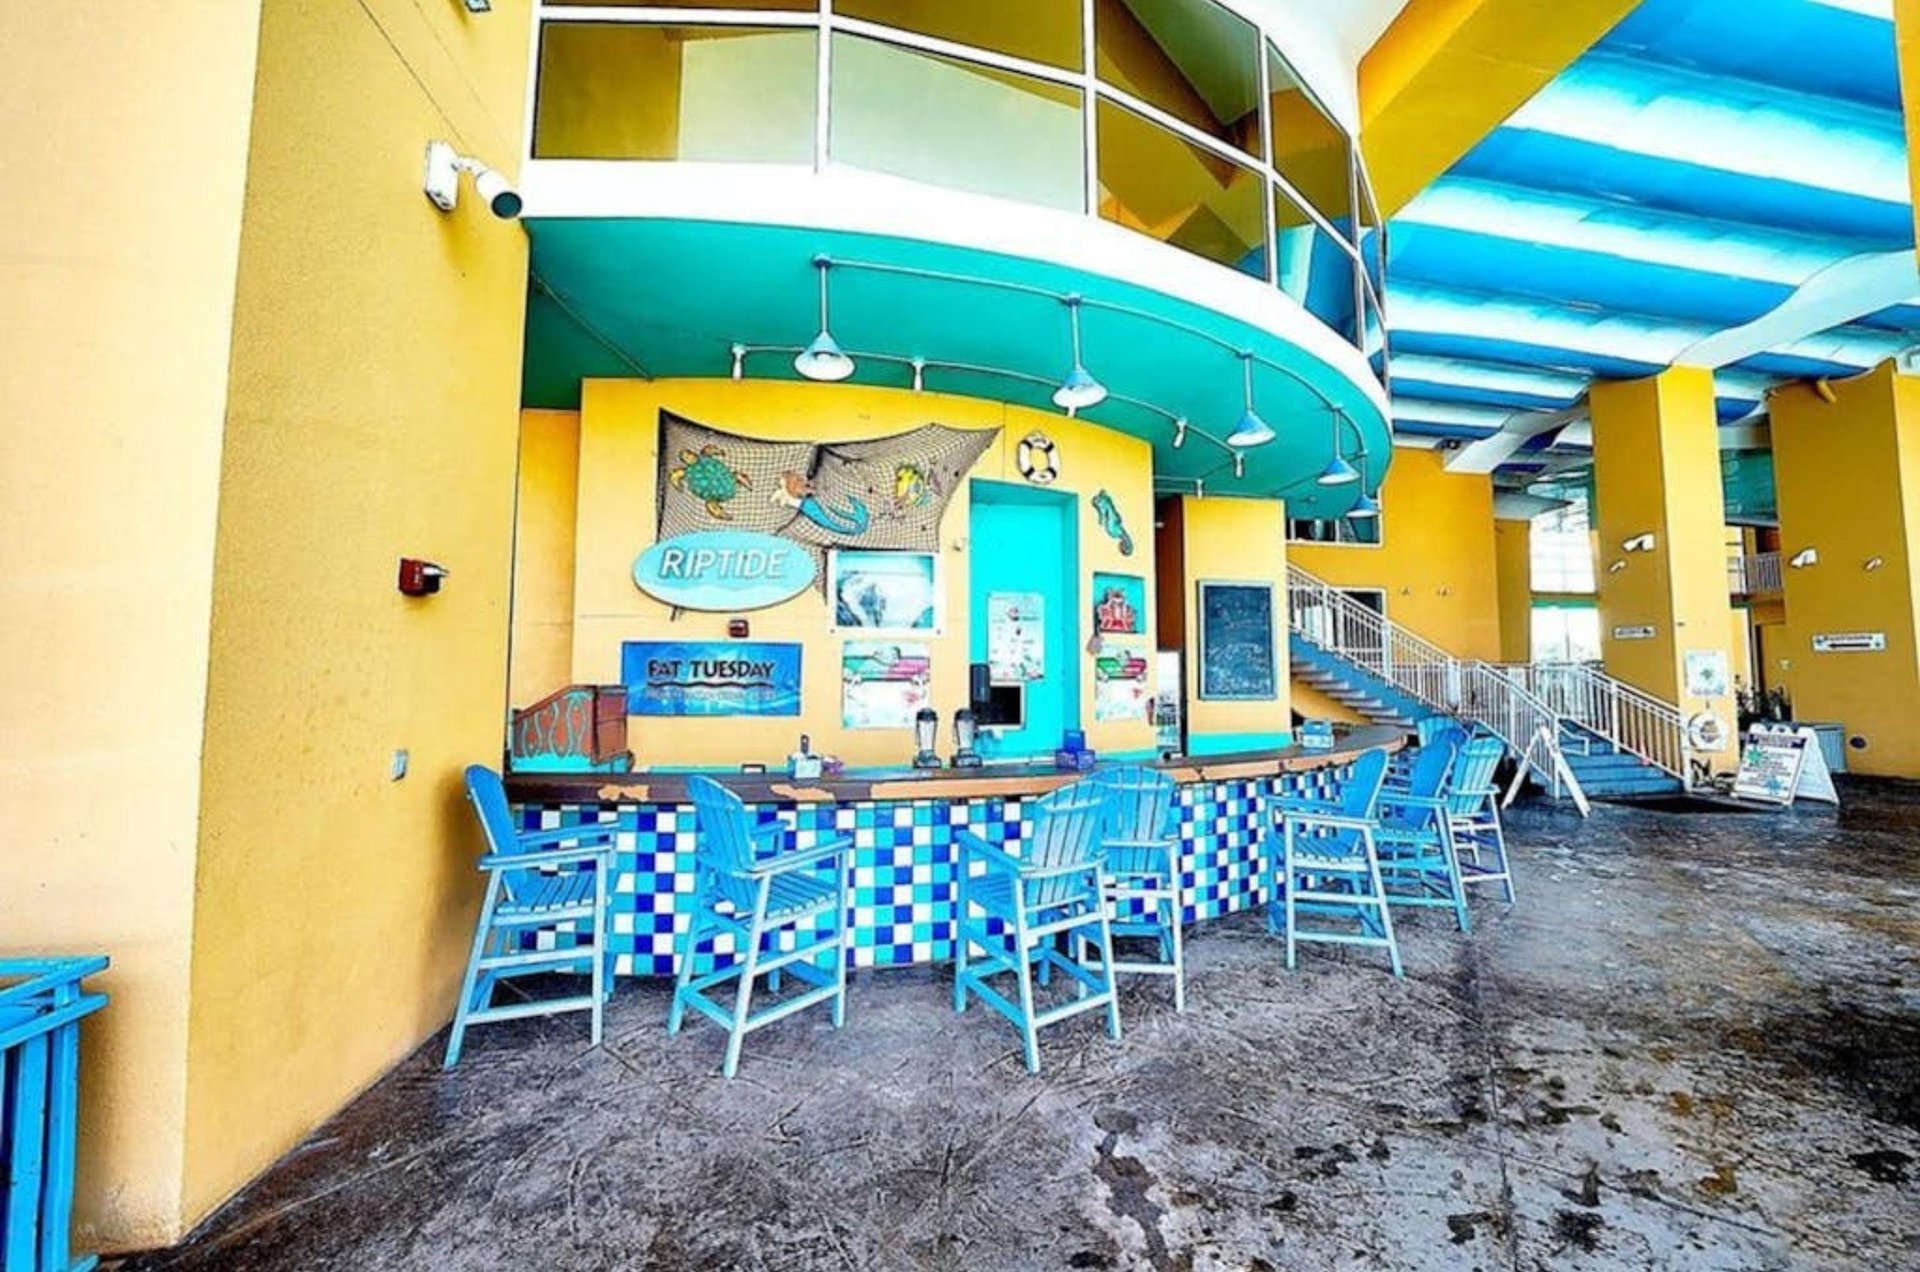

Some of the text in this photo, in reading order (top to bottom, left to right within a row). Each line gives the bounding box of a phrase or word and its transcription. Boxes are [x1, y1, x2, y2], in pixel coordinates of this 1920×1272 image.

[660, 548, 788, 578] RIPTIDE
[648, 659, 774, 678] FAT TUESDAY
